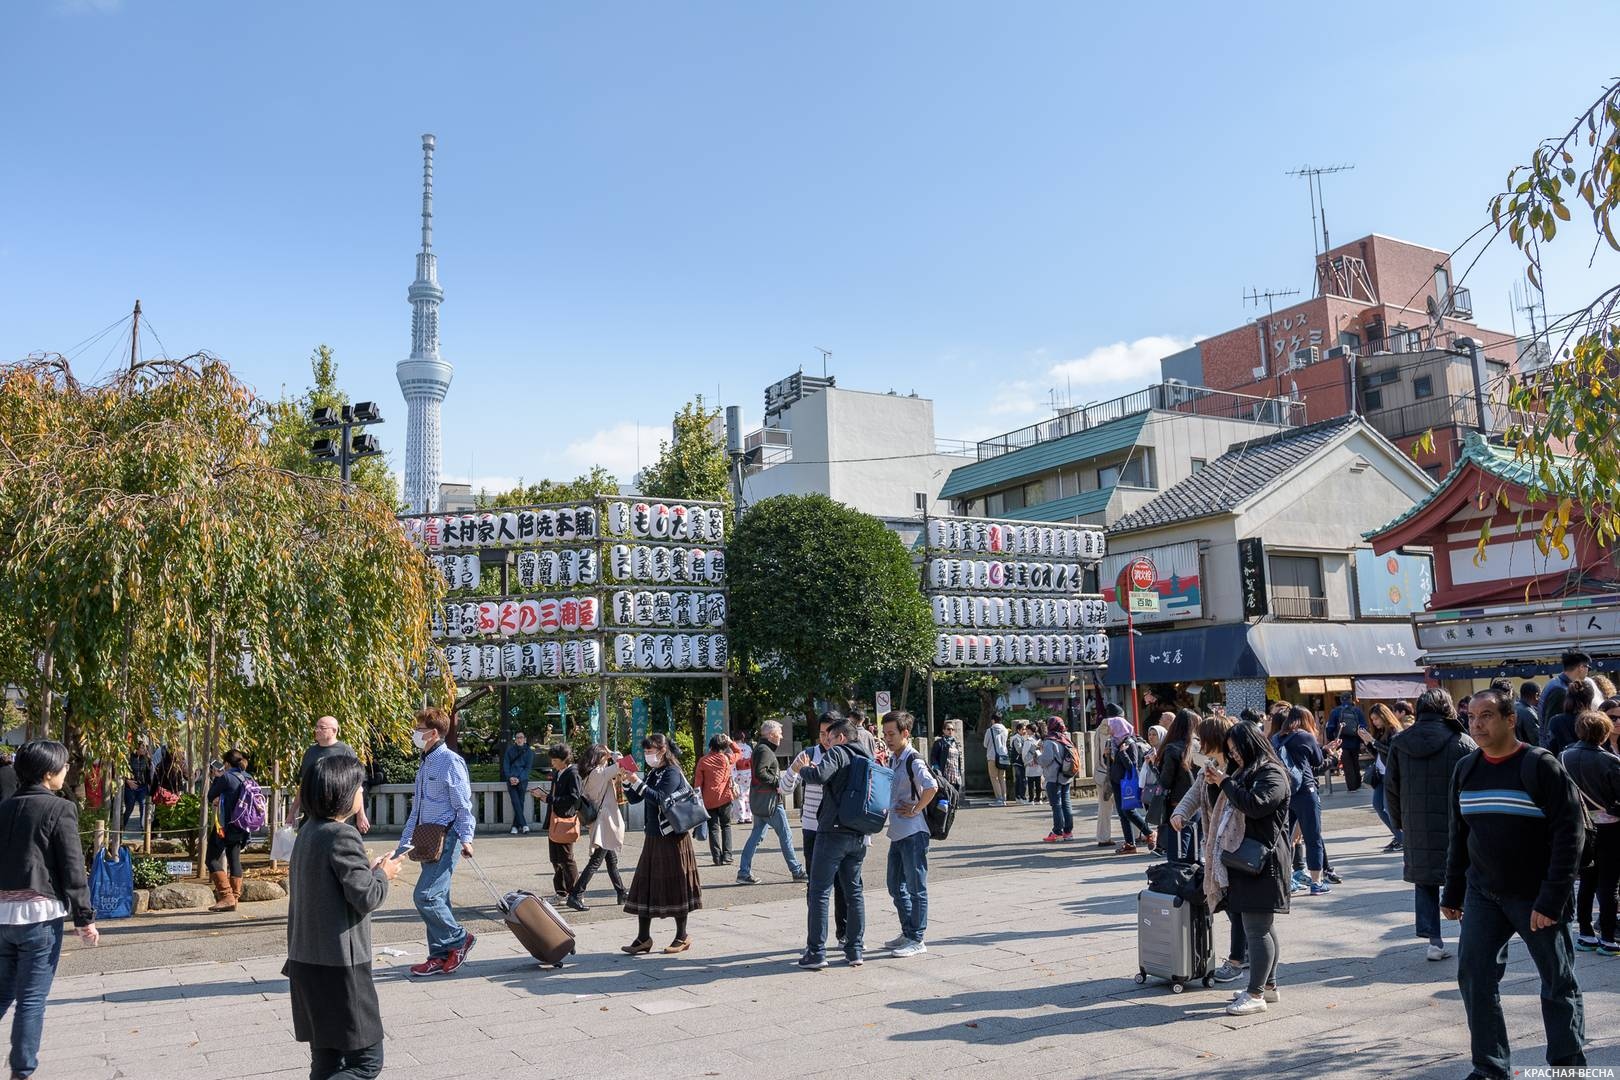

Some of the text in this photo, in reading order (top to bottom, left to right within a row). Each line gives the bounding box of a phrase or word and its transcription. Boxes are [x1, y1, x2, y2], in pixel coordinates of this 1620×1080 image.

[1274, 329, 1324, 358] タケミ
[443, 510, 593, 543] 木村家人形焼本舗
[634, 512, 687, 536] もりた
[709, 509, 722, 539] はなや
[1136, 598, 1153, 607] 百助
[1446, 623, 1533, 640] 浅草寺御用
[1587, 616, 1602, 630] 人
[1149, 648, 1183, 664] 加賀屋
